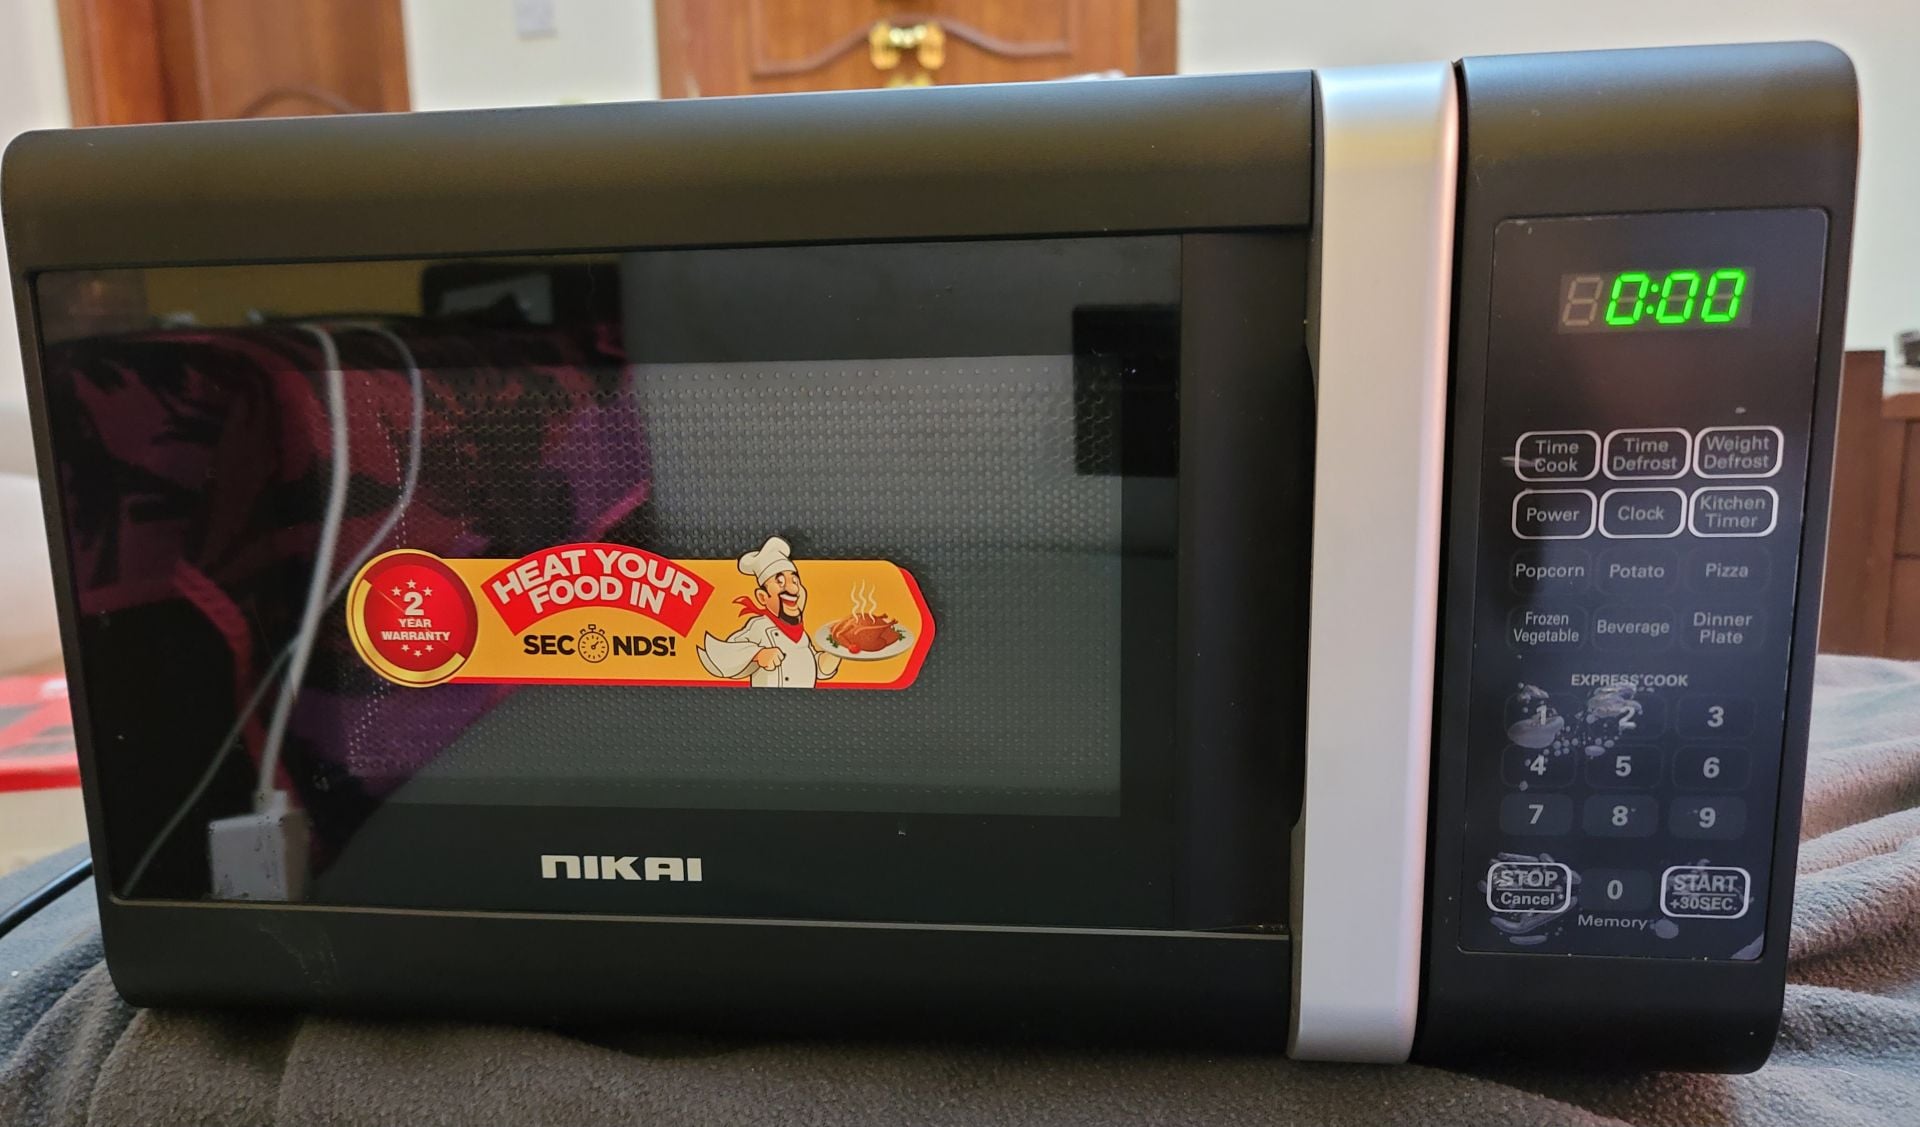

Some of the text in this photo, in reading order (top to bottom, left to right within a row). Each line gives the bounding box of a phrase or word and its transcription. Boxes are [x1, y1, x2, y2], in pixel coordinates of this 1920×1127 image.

[1605, 268, 1747, 326] 0:00
[1535, 440, 1580, 454] Time
[1623, 438, 1669, 453] Time
[1705, 436, 1770, 453] Weight
[1534, 458, 1578, 473] Cook
[1612, 456, 1677, 472] Defrost
[1703, 454, 1770, 469] Defrost
[1700, 495, 1766, 511] Kitchen
[1526, 508, 1580, 522] Power
[1617, 506, 1664, 521] Clock
[1705, 514, 1758, 528] Timer
[491, 548, 700, 606] HEAT YOUR
[1515, 563, 1585, 581] Popcorn
[1609, 563, 1665, 579] Potato
[1705, 562, 1749, 578] Pizza
[403, 591, 425, 616] 2
[529, 575, 666, 616] FOOD IN
[398, 618, 432, 628] YEAR
[1525, 612, 1569, 626] Frozen
[1693, 611, 1753, 627] Dinner
[381, 630, 451, 642] WARRANTY
[1513, 628, 1579, 644] Vegetable
[1596, 619, 1670, 637] Beverage
[1699, 630, 1743, 645] Plate
[1571, 673, 1688, 687] EXPRESS COOK
[1535, 704, 1548, 726] 1
[1618, 705, 1637, 727] 2
[1706, 705, 1725, 728] 3
[1529, 755, 1547, 775] 4
[1615, 755, 1632, 777] 5
[1702, 757, 1720, 778] 6
[1528, 804, 1544, 824] 7
[1611, 805, 1629, 826] 8
[1699, 806, 1716, 828] 9
[541, 854, 703, 882] NIKAI
[1499, 870, 1558, 888] STOP
[1673, 874, 1738, 893] START
[1607, 879, 1623, 900] 0
[1500, 891, 1555, 906] Cancel
[1577, 914, 1648, 930] Memory
